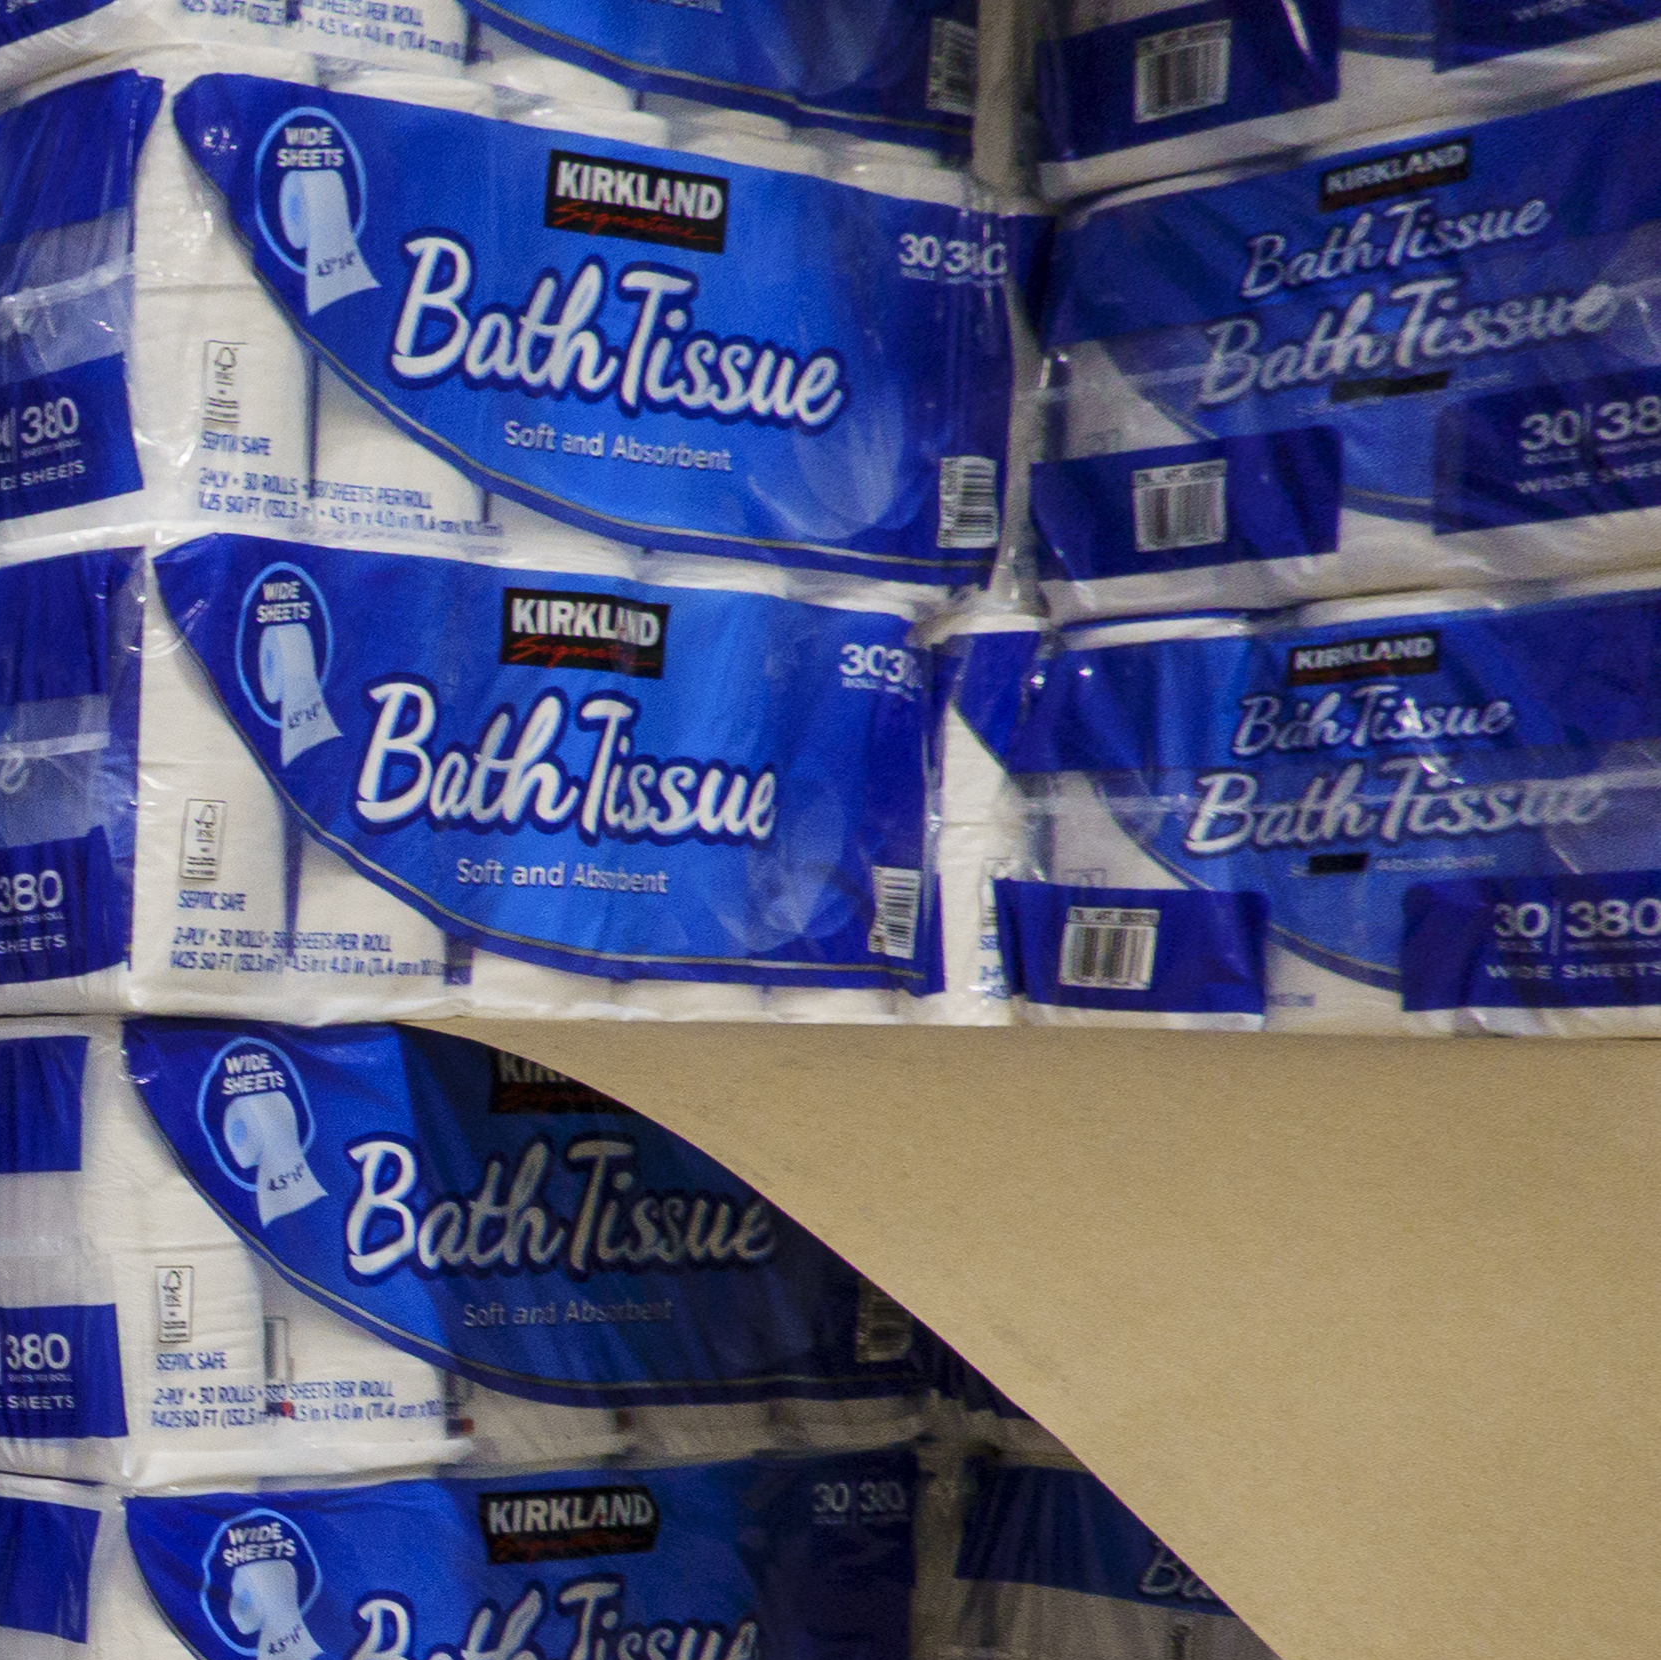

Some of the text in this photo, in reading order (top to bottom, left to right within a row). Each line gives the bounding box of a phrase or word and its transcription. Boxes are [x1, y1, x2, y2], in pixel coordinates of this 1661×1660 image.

[277, 146, 344, 169] SHEETS
[286, 127, 332, 148] WIDE
[556, 160, 724, 220] KIRKLAND
[1327, 145, 1466, 192] KIRKLAND
[1241, 200, 1552, 297] Bath Tissue
[393, 237, 842, 427] Bath Tissue
[20, 400, 79, 445] 380
[504, 420, 732, 473] Soft and Absorbent
[358, 683, 776, 839] Bath Tissue
[1186, 753, 1608, 855] Bath Tissue
[346, 1141, 774, 1275] Bath Tissue
[488, 1497, 653, 1532] KIRKLAND
